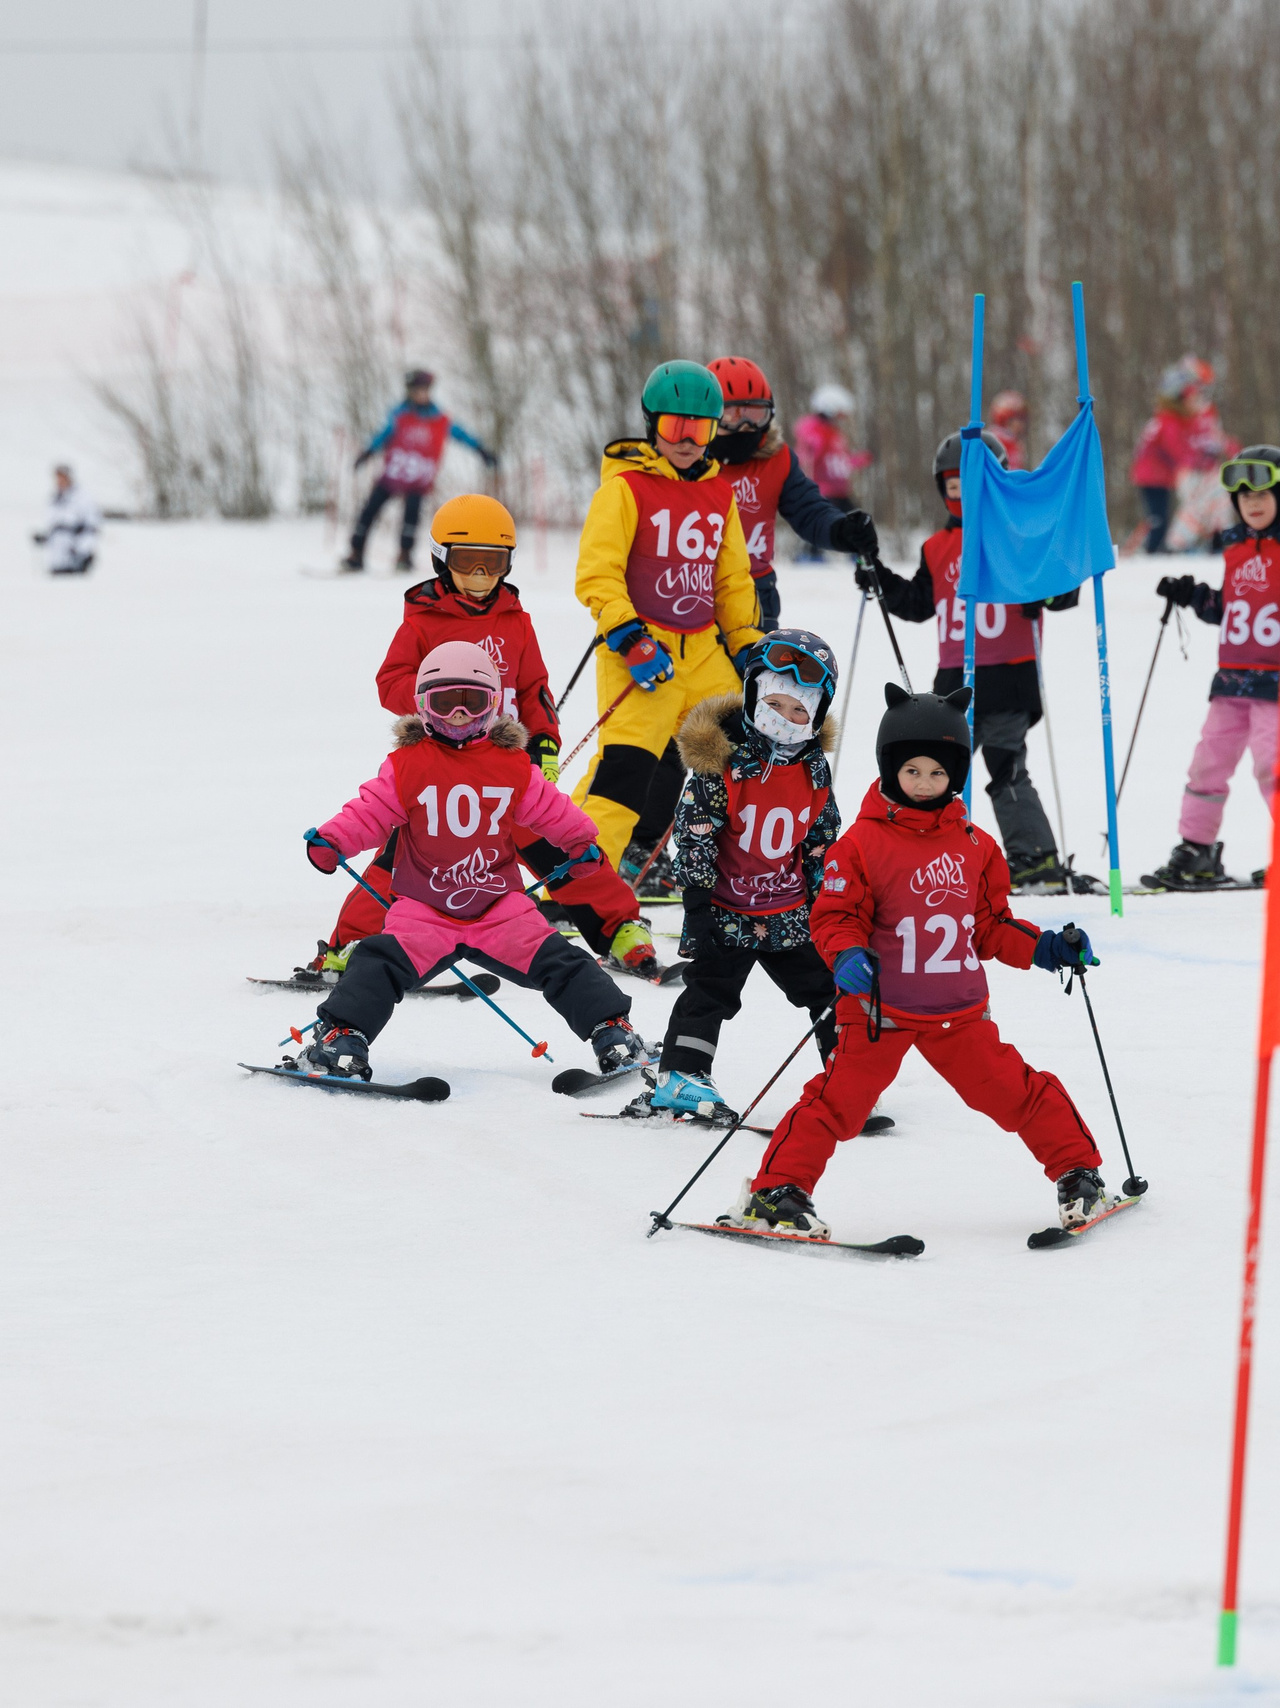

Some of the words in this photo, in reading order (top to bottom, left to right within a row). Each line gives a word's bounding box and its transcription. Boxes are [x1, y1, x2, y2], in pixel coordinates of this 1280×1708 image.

[650, 509, 725, 560] 163
[936, 598, 1007, 643] 150
[417, 784, 514, 838] 107
[895, 914, 979, 973] 123
